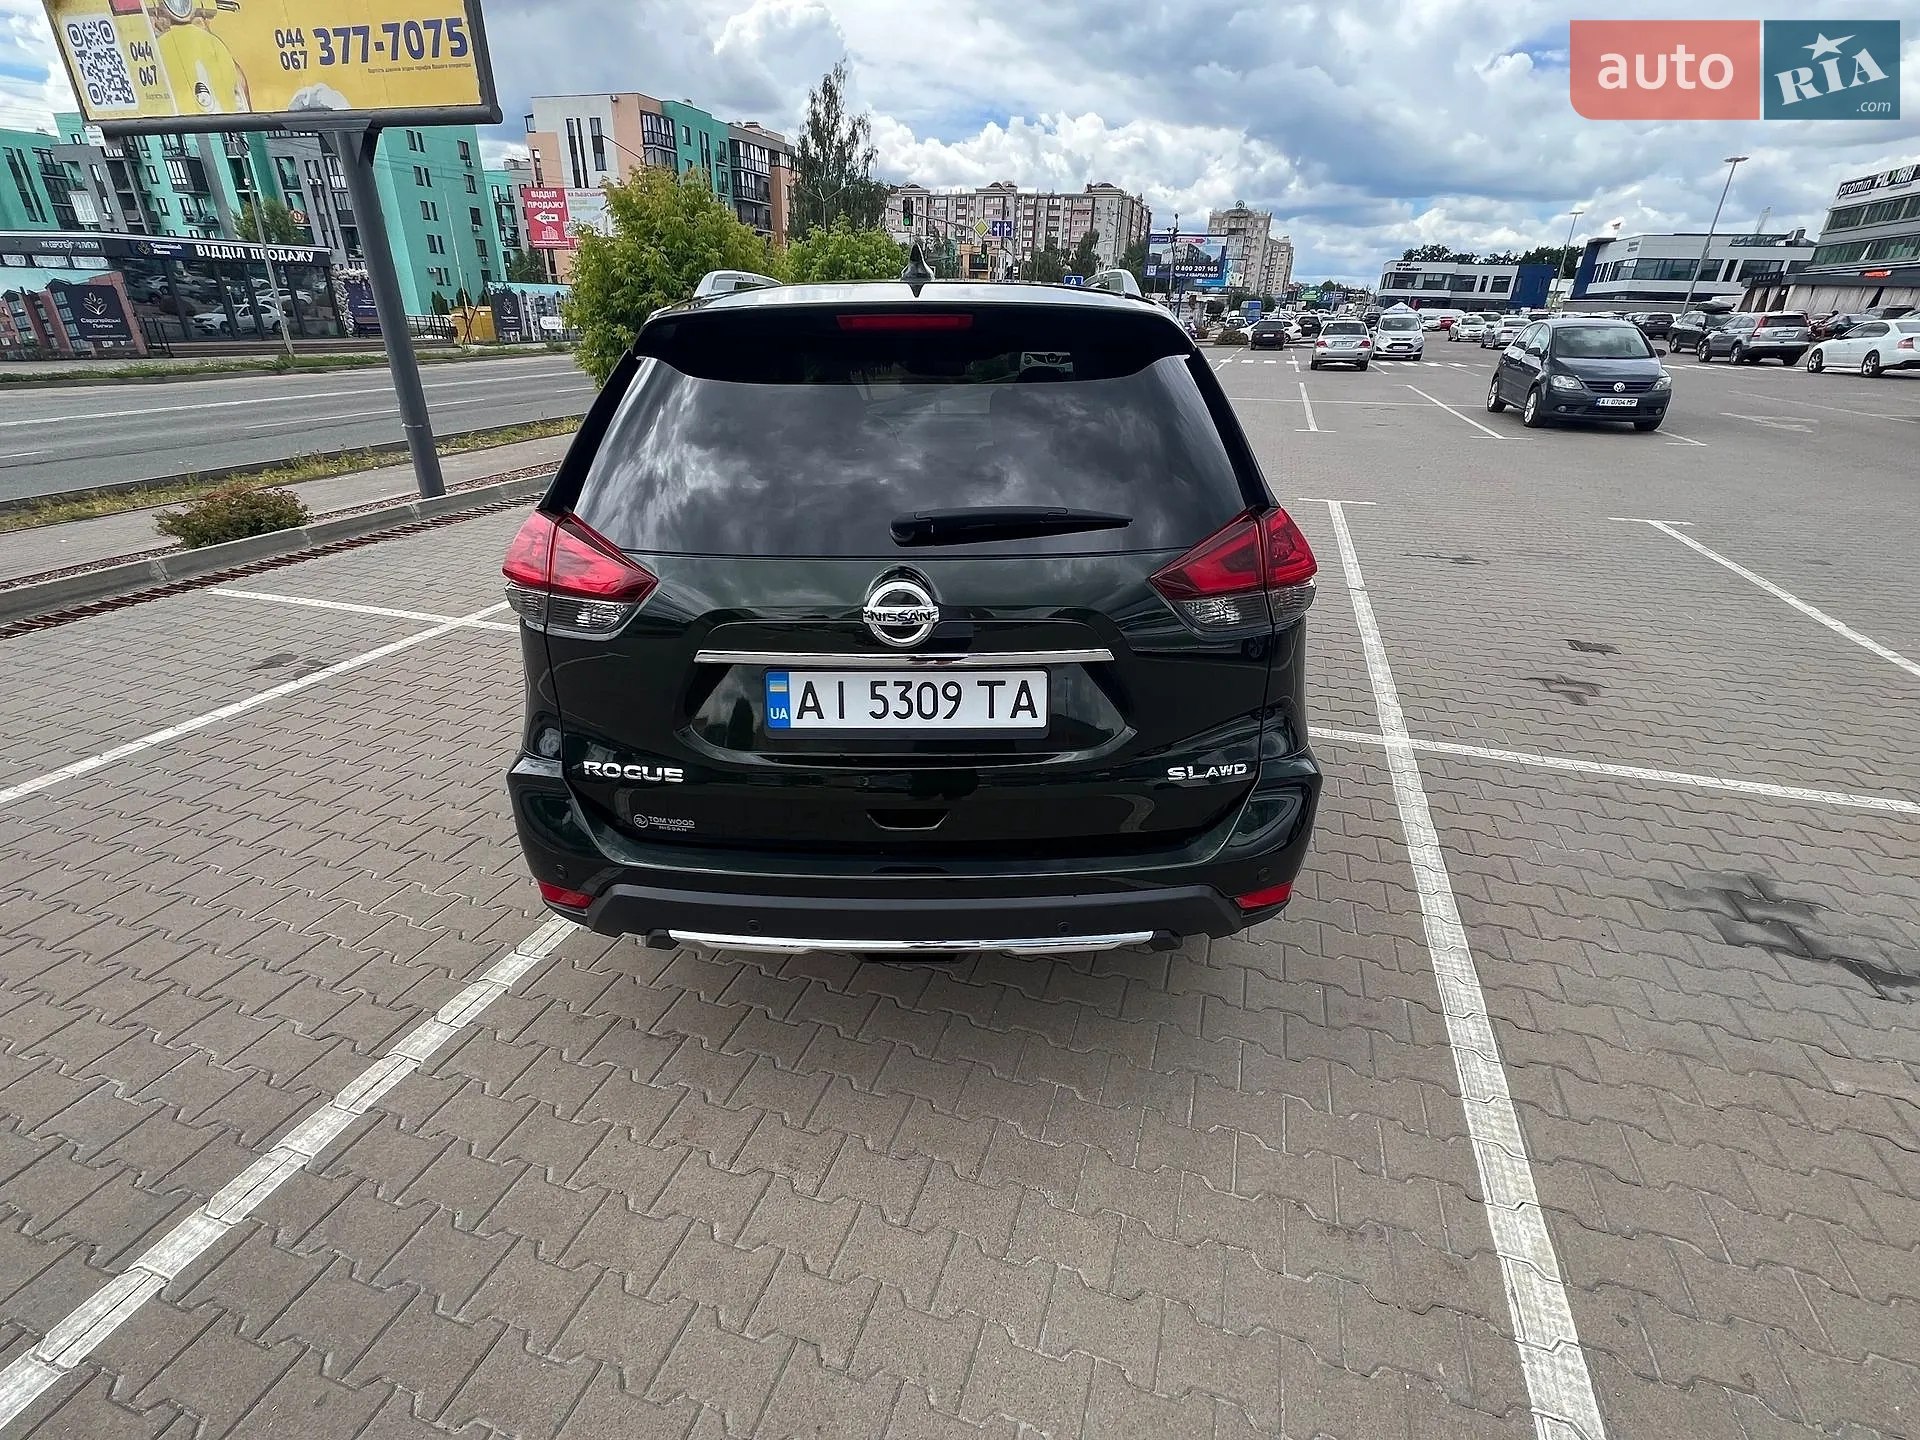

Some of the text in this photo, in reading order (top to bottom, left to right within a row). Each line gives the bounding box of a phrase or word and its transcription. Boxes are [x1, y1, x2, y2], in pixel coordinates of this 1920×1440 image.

[274, 28, 305, 49] 044
[312, 18, 468, 66] 377-7075
[129, 41, 154, 61] 044
[279, 51, 308, 71] 067
[139, 65, 158, 87] 067
[530, 190, 557, 199] ВІДДІЛ
[1837, 180, 1872, 200] promin
[527, 201, 564, 210] ПРОДАЖУ
[195, 244, 246, 260] ВІДДІЛ
[870, 611, 931, 623] NISSAN
[868, 680, 963, 721] 5309
[976, 680, 1038, 719] TA
[770, 708, 788, 720] UA
[582, 760, 685, 783] ROGUE
[648, 815, 695, 826] TOM WOOD
